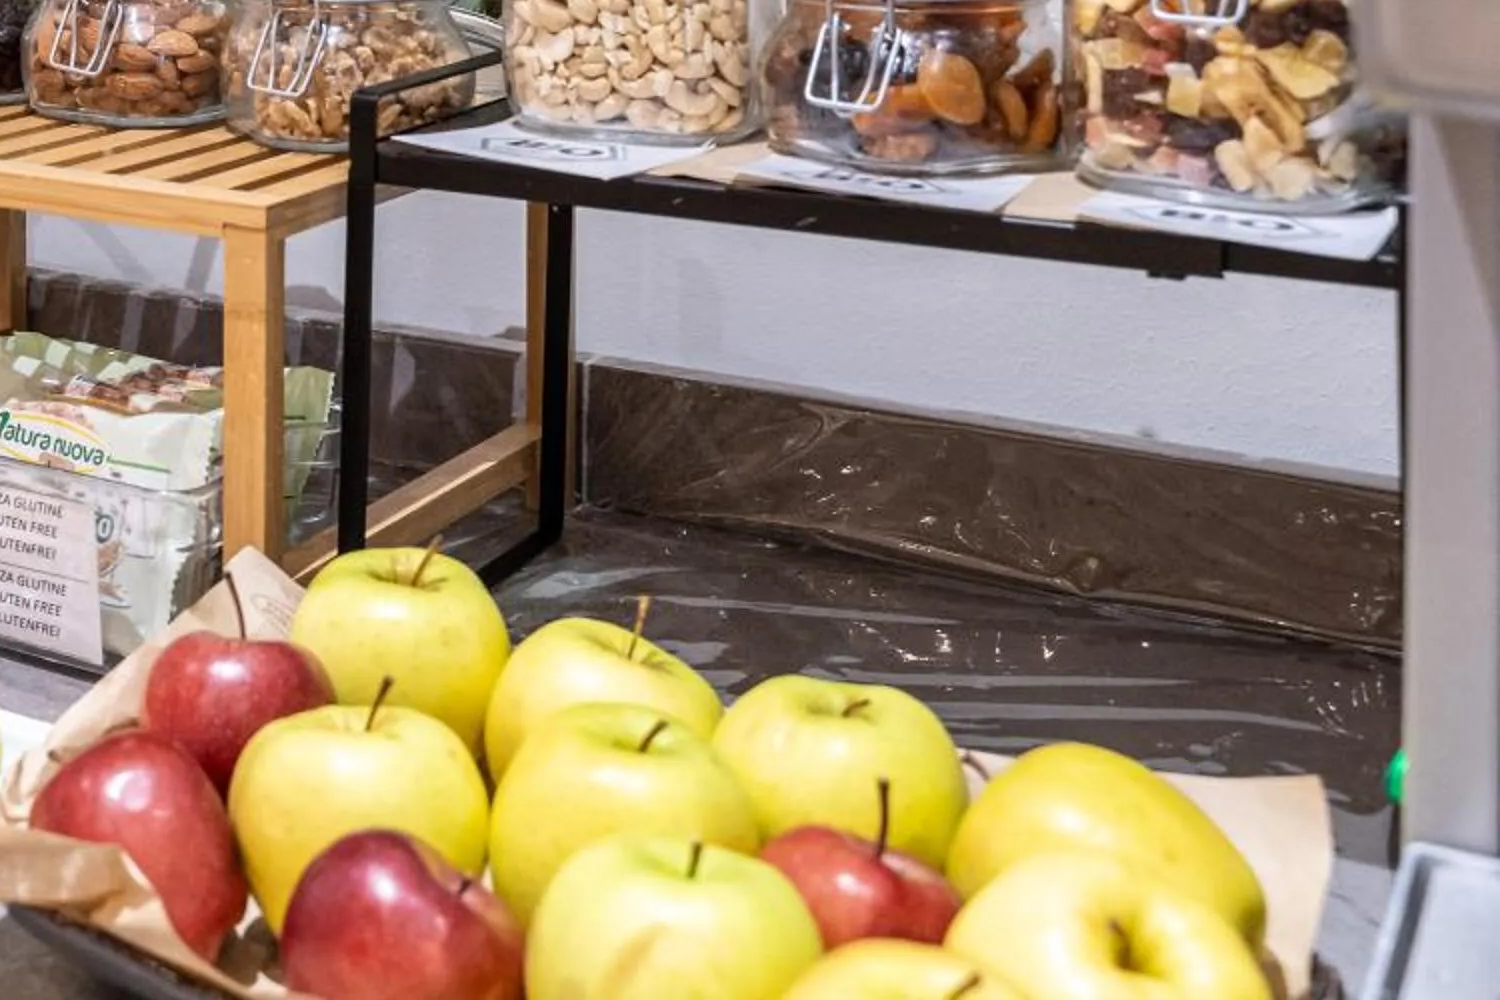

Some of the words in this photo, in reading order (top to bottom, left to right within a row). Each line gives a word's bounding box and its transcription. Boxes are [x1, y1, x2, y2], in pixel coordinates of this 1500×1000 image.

[52, 437, 106, 466] nuova
[13, 497, 63, 519] GLUTINE
[29, 521, 58, 540] FREE
[16, 574, 67, 598] GLUTINE
[32, 599, 63, 617] FREE
